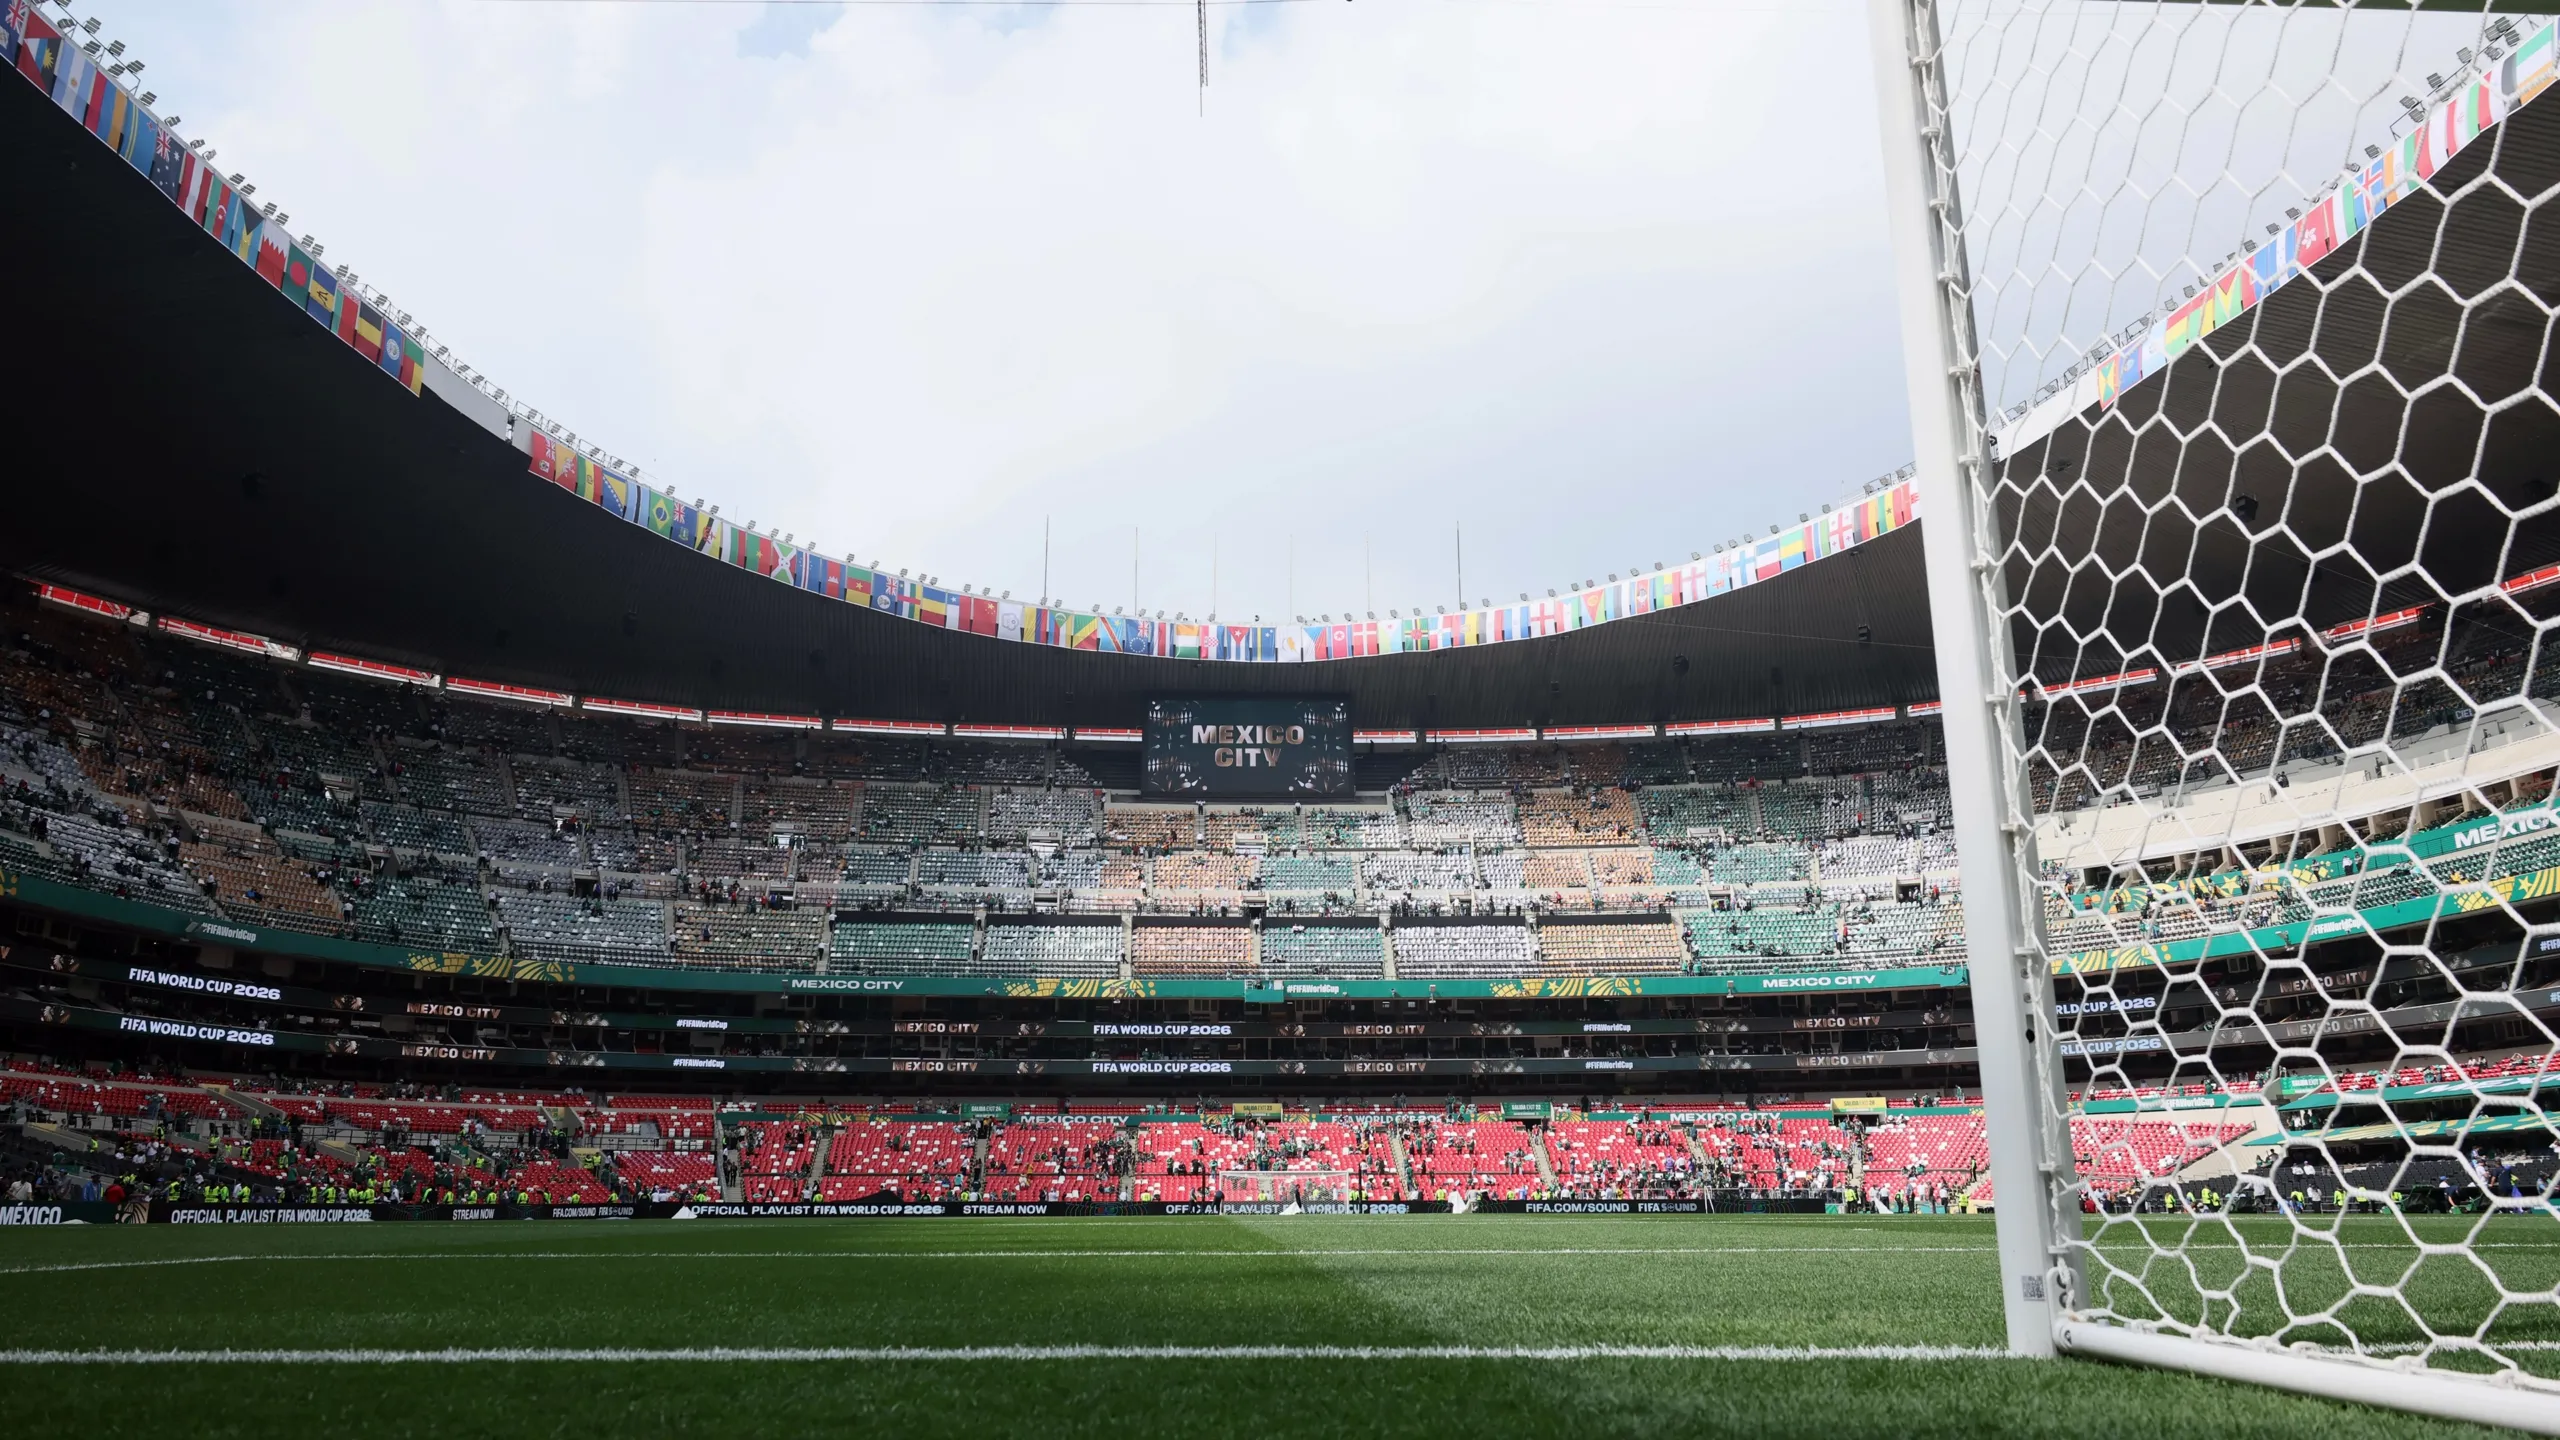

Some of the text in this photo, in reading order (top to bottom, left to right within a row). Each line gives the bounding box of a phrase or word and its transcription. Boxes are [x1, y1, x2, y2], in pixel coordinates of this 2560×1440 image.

[1192, 725, 1304, 744] MEXICO
[1215, 748, 1282, 767] CITY
[201, 922, 256, 943] #FIFAWorldCup
[129, 968, 281, 1000] FIFA WORLD CUP 2026
[791, 979, 904, 990] MEXICO CITY
[1762, 975, 1876, 988] MEXICO CITY
[2280, 971, 2367, 993] MEXCO CITY
[1287, 984, 1340, 994] #FIFAWorldCup
[406, 1003, 501, 1019] MEXICO CITY
[2056, 997, 2156, 1015] RLD CUP 2026
[676, 1019, 728, 1030] #FIFAWorldCup
[894, 1023, 980, 1033] MEXICO CITY
[1583, 1023, 1632, 1033] #FIFAWorldCup
[1793, 1016, 1881, 1029] MEXICO CITY
[120, 1017, 274, 1045] FIFA WORLD CUP 2026
[1093, 1025, 1231, 1035] FIFA WORLD CUP 2026
[1343, 1025, 1426, 1035] MEXICO CITY
[2061, 1038, 2161, 1055] RLD CUP 2026
[401, 1045, 497, 1060] MEXICO CITY
[673, 1058, 725, 1069] #FIFAWorldCup
[1585, 1061, 1634, 1070] #FIFAWorldCup
[1796, 1054, 1885, 1067] MEXICO CITY
[892, 1062, 978, 1072] MEXICO CITY
[1092, 1063, 1231, 1073] FIFA WORLD CUP 2026
[1343, 1062, 1427, 1072] MEXICO CITY
[1020, 1115, 1129, 1124] MEXICO CITY
[1355, 1115, 1394, 1124] WORLD
[1669, 1112, 1781, 1122] MEXICO CITY
[552, 1208, 596, 1218] FIFA.COM/SOUND
[598, 1207, 608, 1216] FIFA
[691, 1205, 942, 1216] OFFICIAL PLAYLIST FIFA WORLD CUP 2026
[963, 1205, 1048, 1215] STREAM NOW
[1223, 1204, 1280, 1214] PLAYLIST
[1306, 1204, 1345, 1214] WORLD
[1347, 1204, 1368, 1214] CUP
[1369, 1204, 1407, 1214] 2026
[1525, 1202, 1630, 1213] FIFA.COM/SOUND
[1638, 1202, 1660, 1212] FIFA
[0, 1203, 61, 1224] MÉXICO
[171, 1209, 369, 1224] OFFICIAL PLAYLIST FIFA WORLD CUP 2026
[452, 1208, 495, 1220] STREAM NOW
